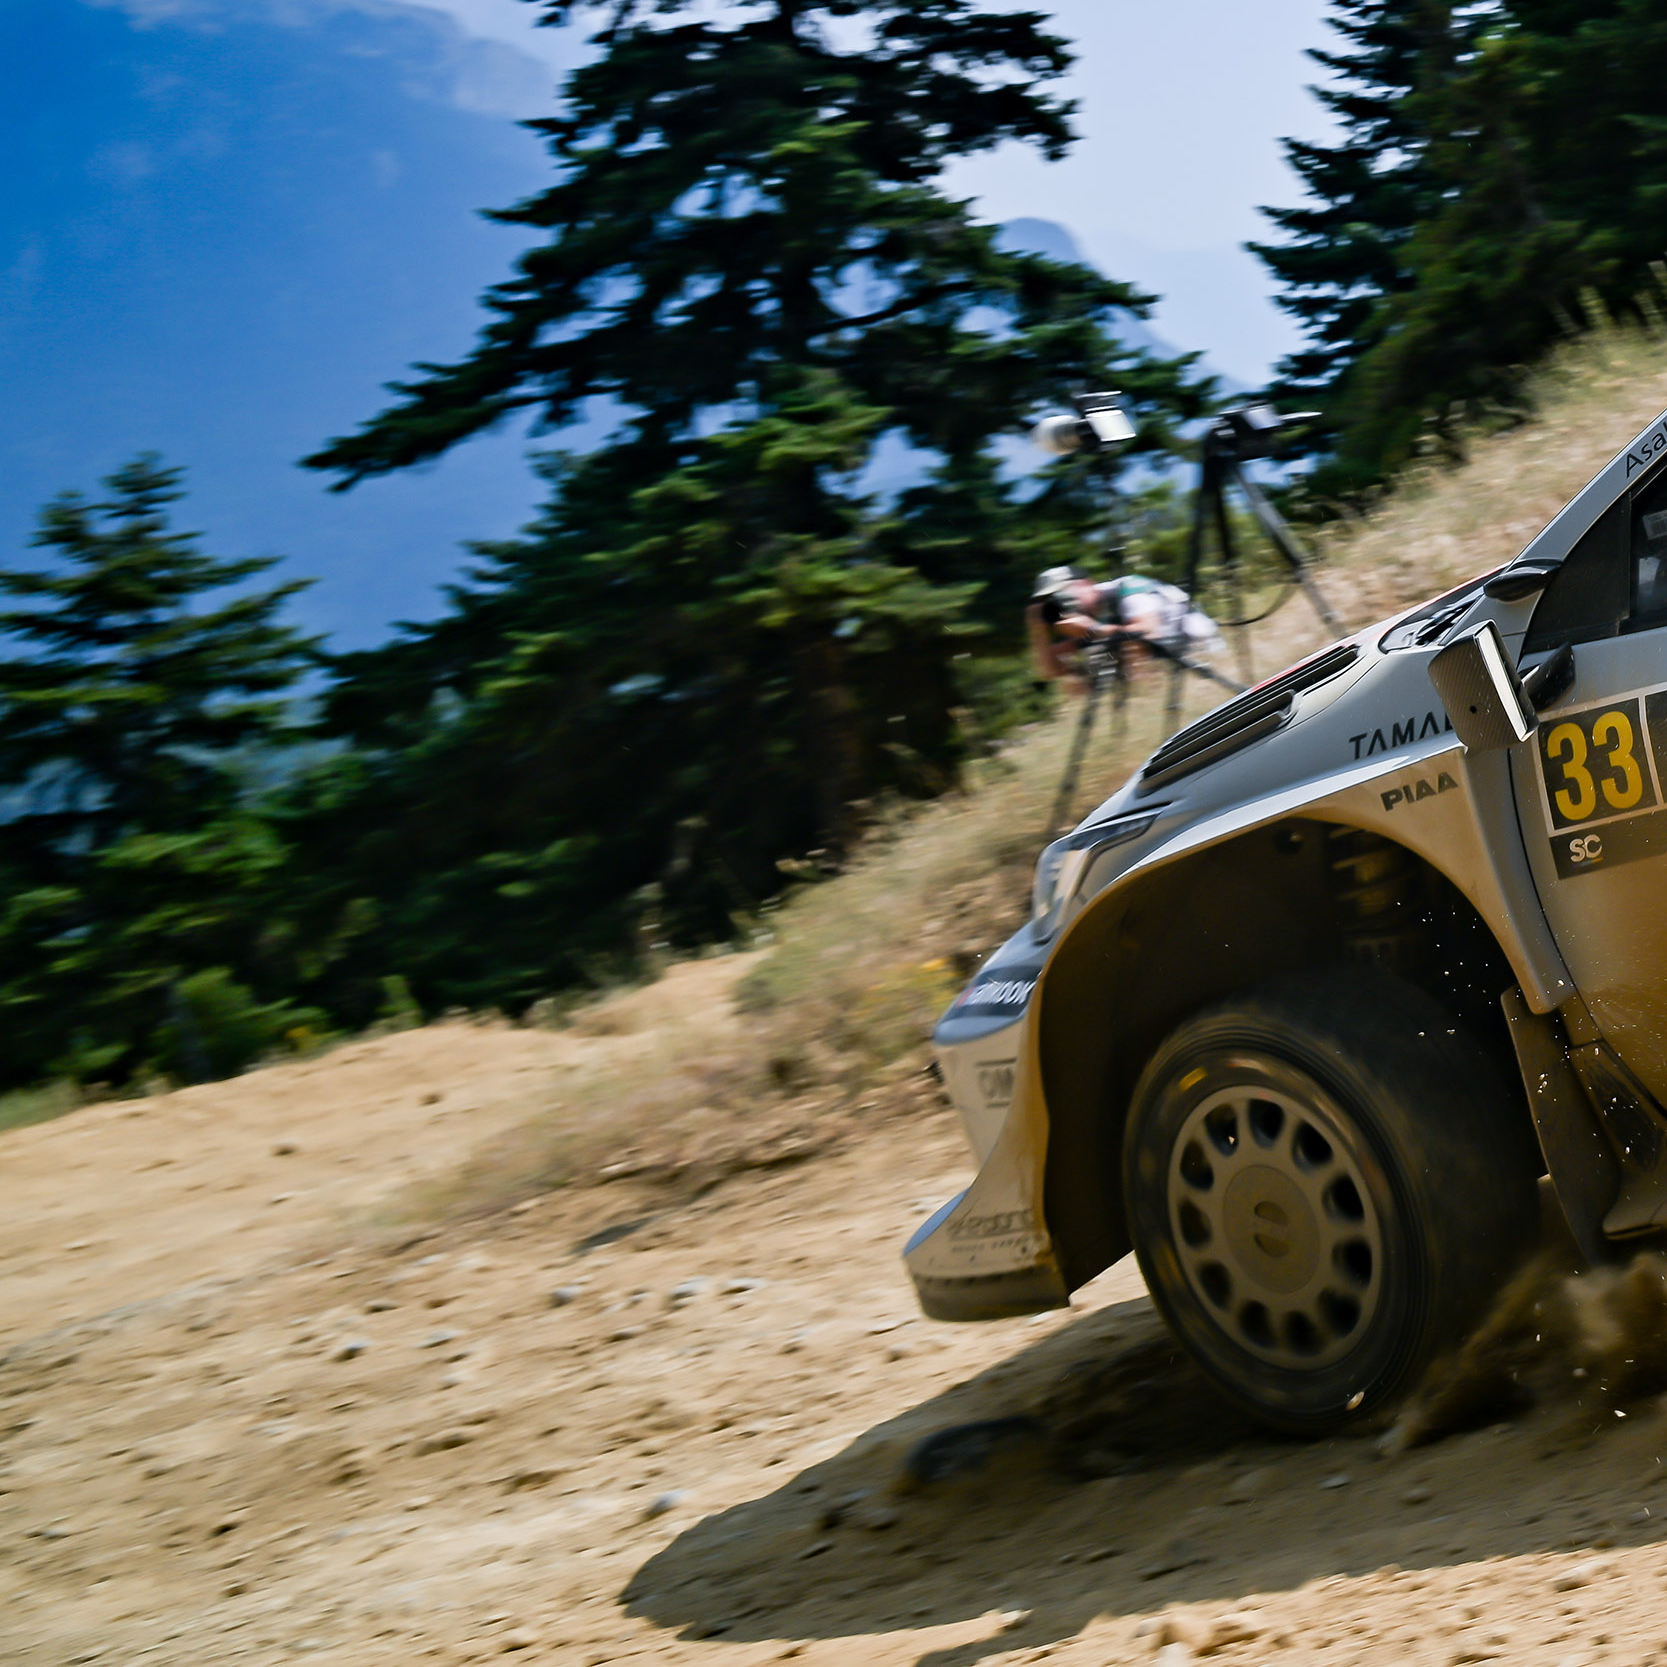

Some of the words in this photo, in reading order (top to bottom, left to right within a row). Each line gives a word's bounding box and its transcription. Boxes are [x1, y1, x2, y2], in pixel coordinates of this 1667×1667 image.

[1547, 710, 1643, 821] 33
[1380, 772, 1458, 812] PIAA
[1570, 834, 1603, 863] SC
